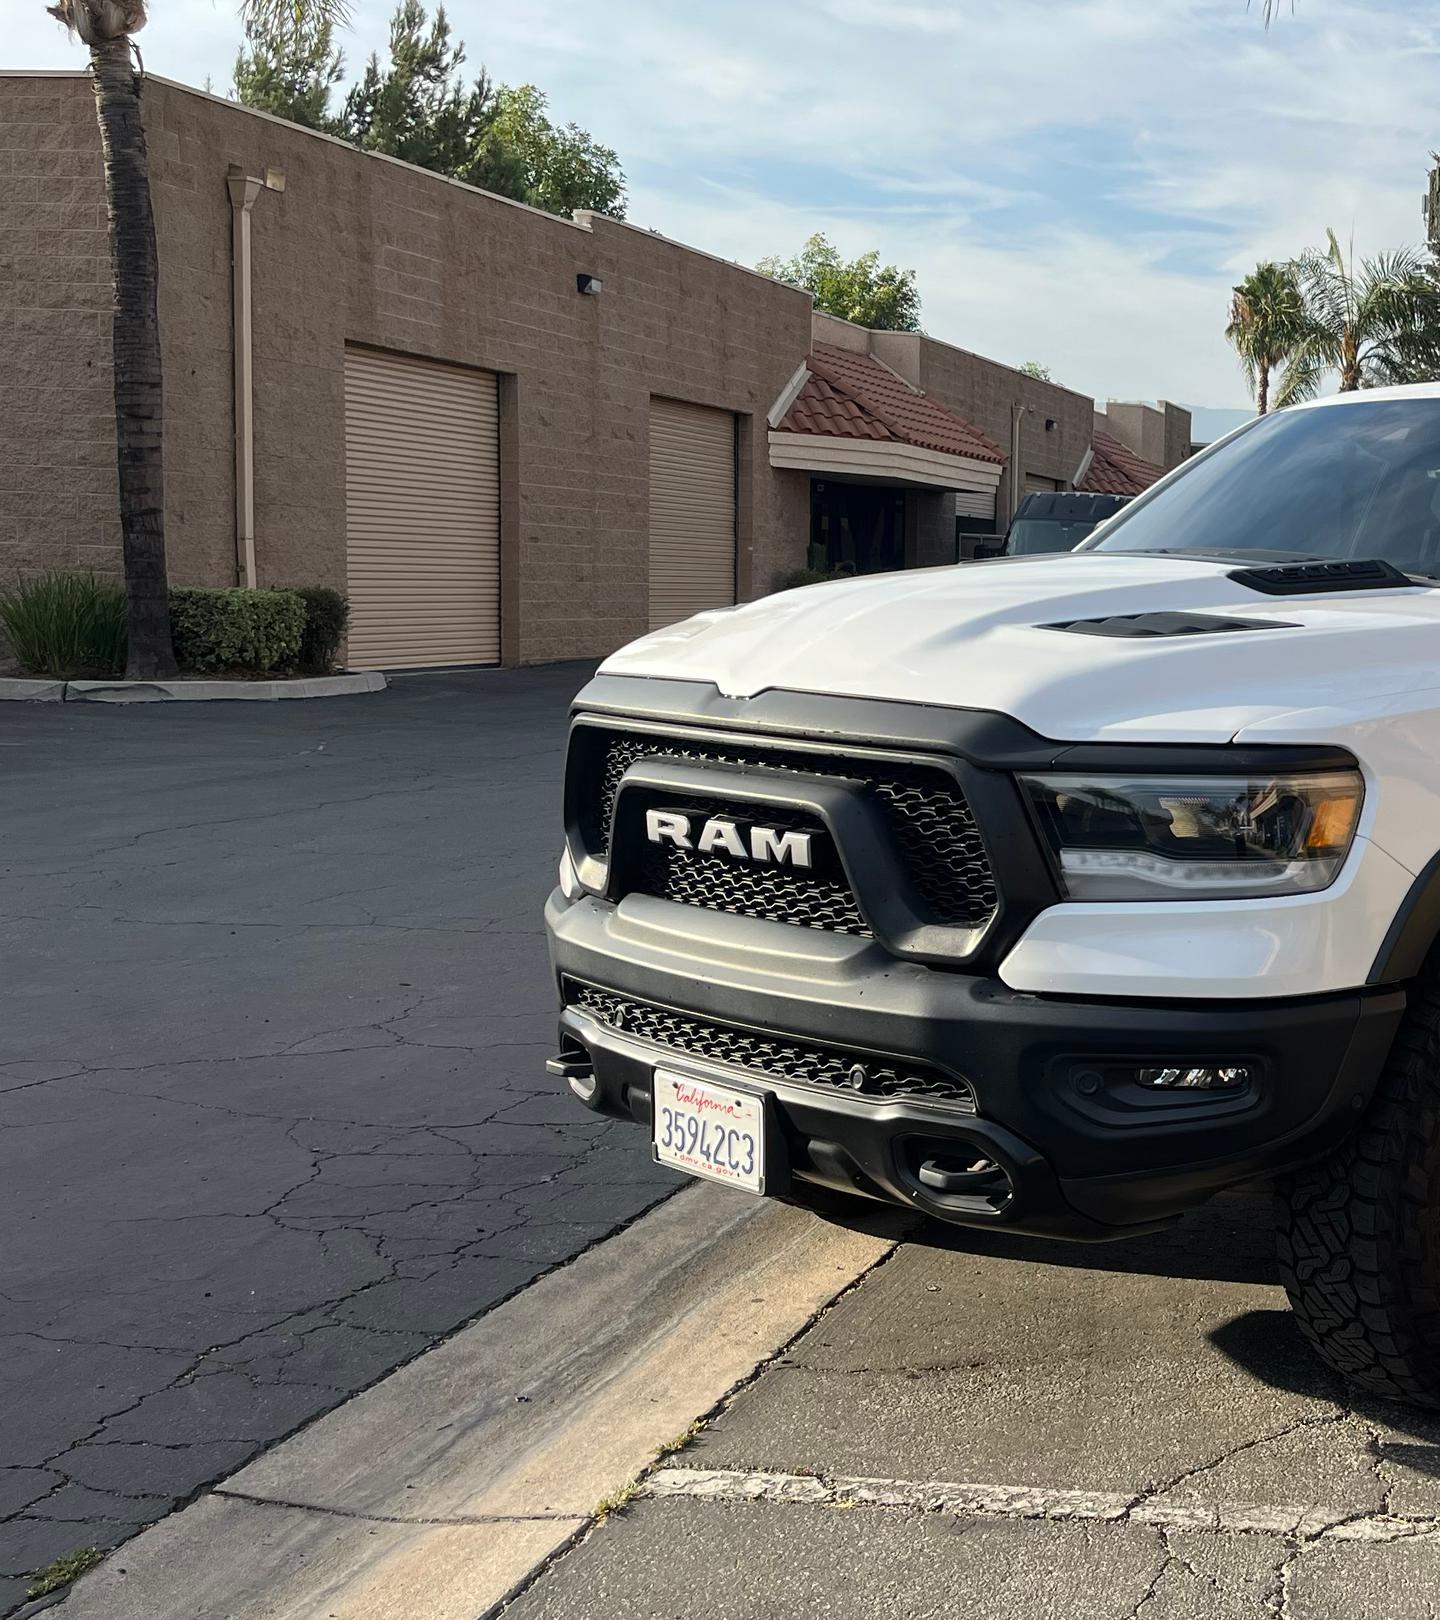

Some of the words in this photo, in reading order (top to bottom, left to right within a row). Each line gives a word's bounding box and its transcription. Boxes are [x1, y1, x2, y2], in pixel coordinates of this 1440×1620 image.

[646, 809, 813, 869] RAM
[675, 1083, 742, 1119] California
[661, 1107, 754, 1175] 35942C3
[679, 1154, 735, 1177] dmv.ca.gov
